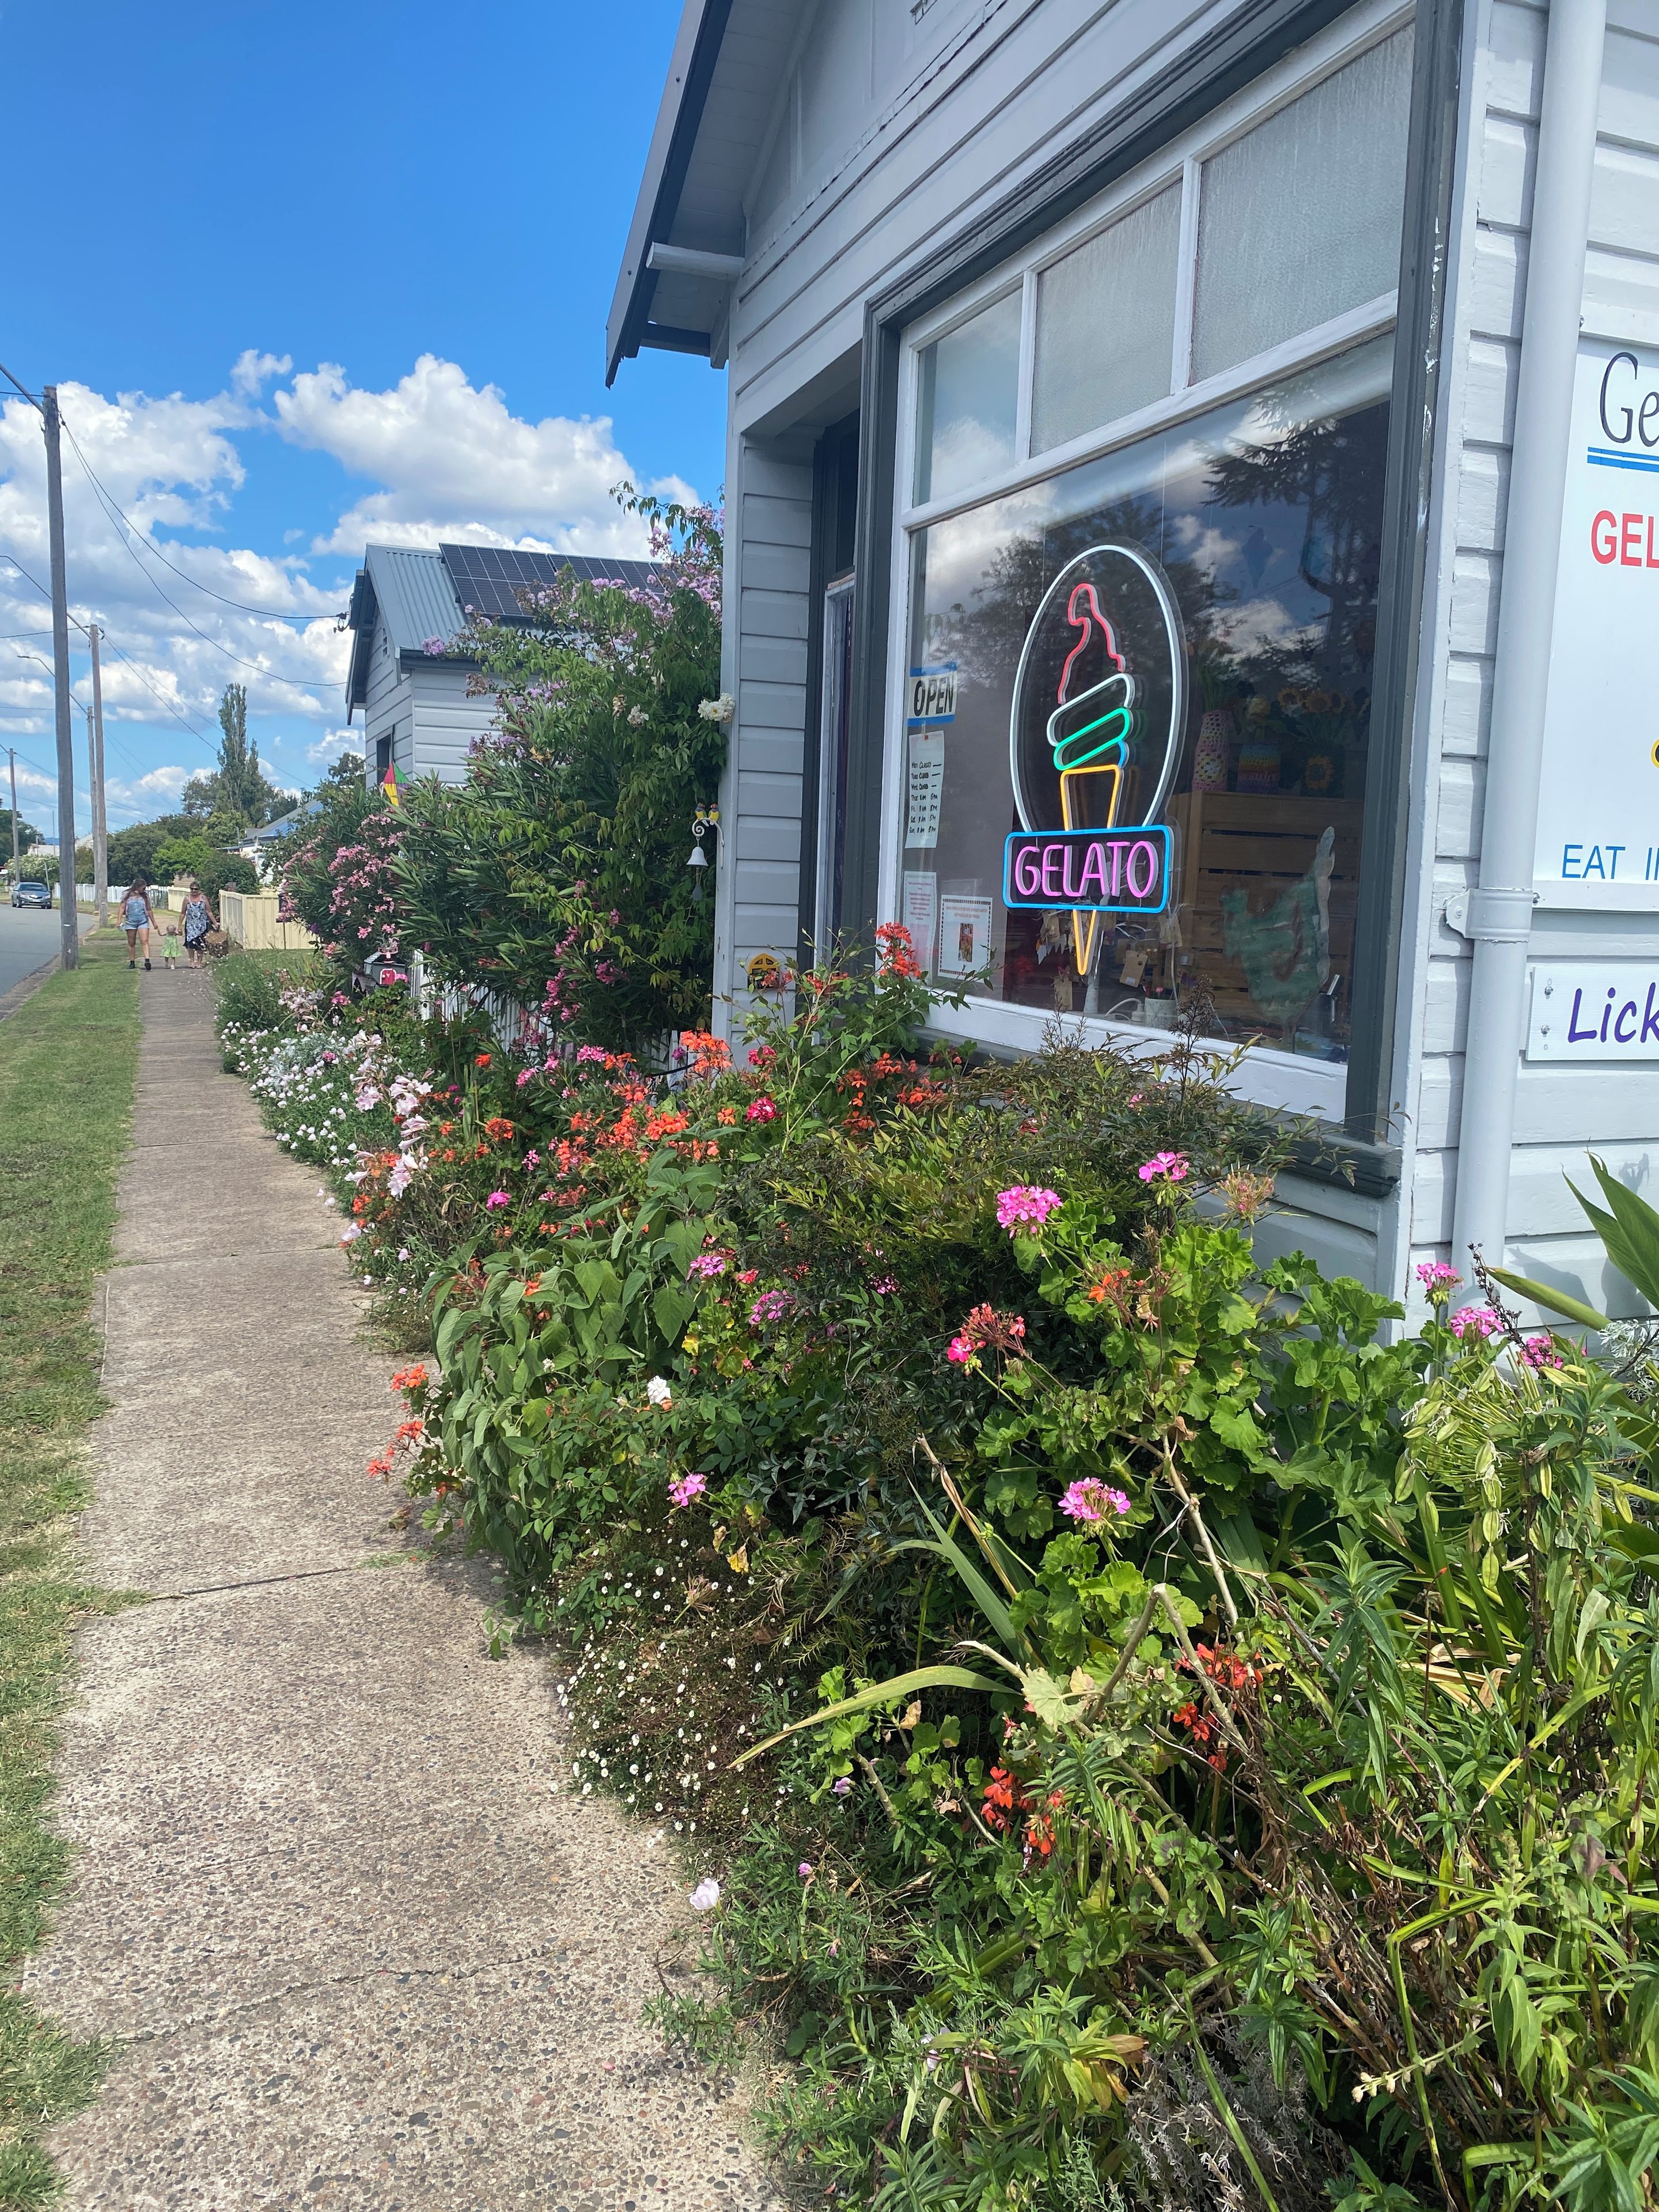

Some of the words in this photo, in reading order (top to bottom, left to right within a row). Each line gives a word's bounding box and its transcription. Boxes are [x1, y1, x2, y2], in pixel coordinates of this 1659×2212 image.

[914, 676, 953, 717] OPEN
[1015, 840, 1156, 899] GELATO
[1561, 844, 1626, 880] EAT
